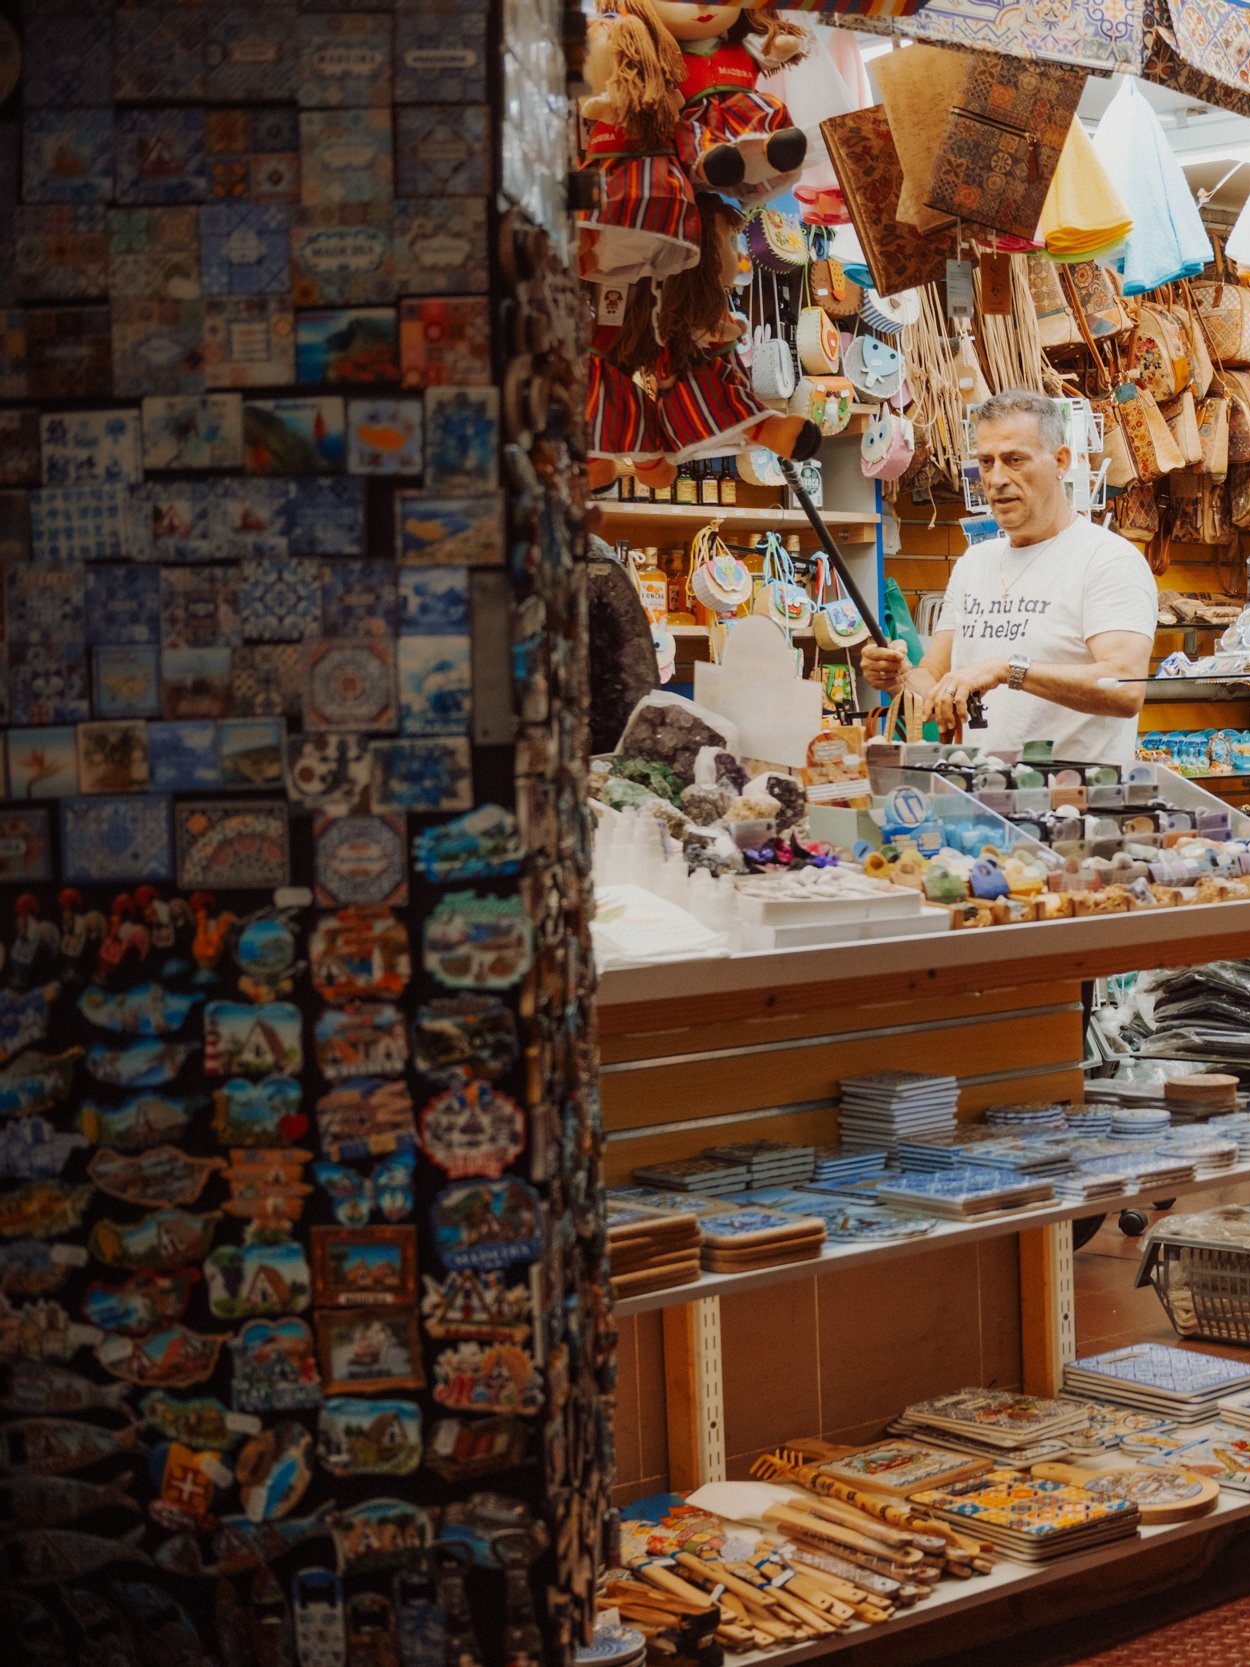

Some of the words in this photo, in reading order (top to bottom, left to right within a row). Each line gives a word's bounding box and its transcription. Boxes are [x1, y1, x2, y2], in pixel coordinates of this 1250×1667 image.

[988, 600, 1013, 614] nu
[1017, 596, 1051, 614] tar
[962, 619, 978, 638] vi
[980, 619, 1029, 641] helg!
